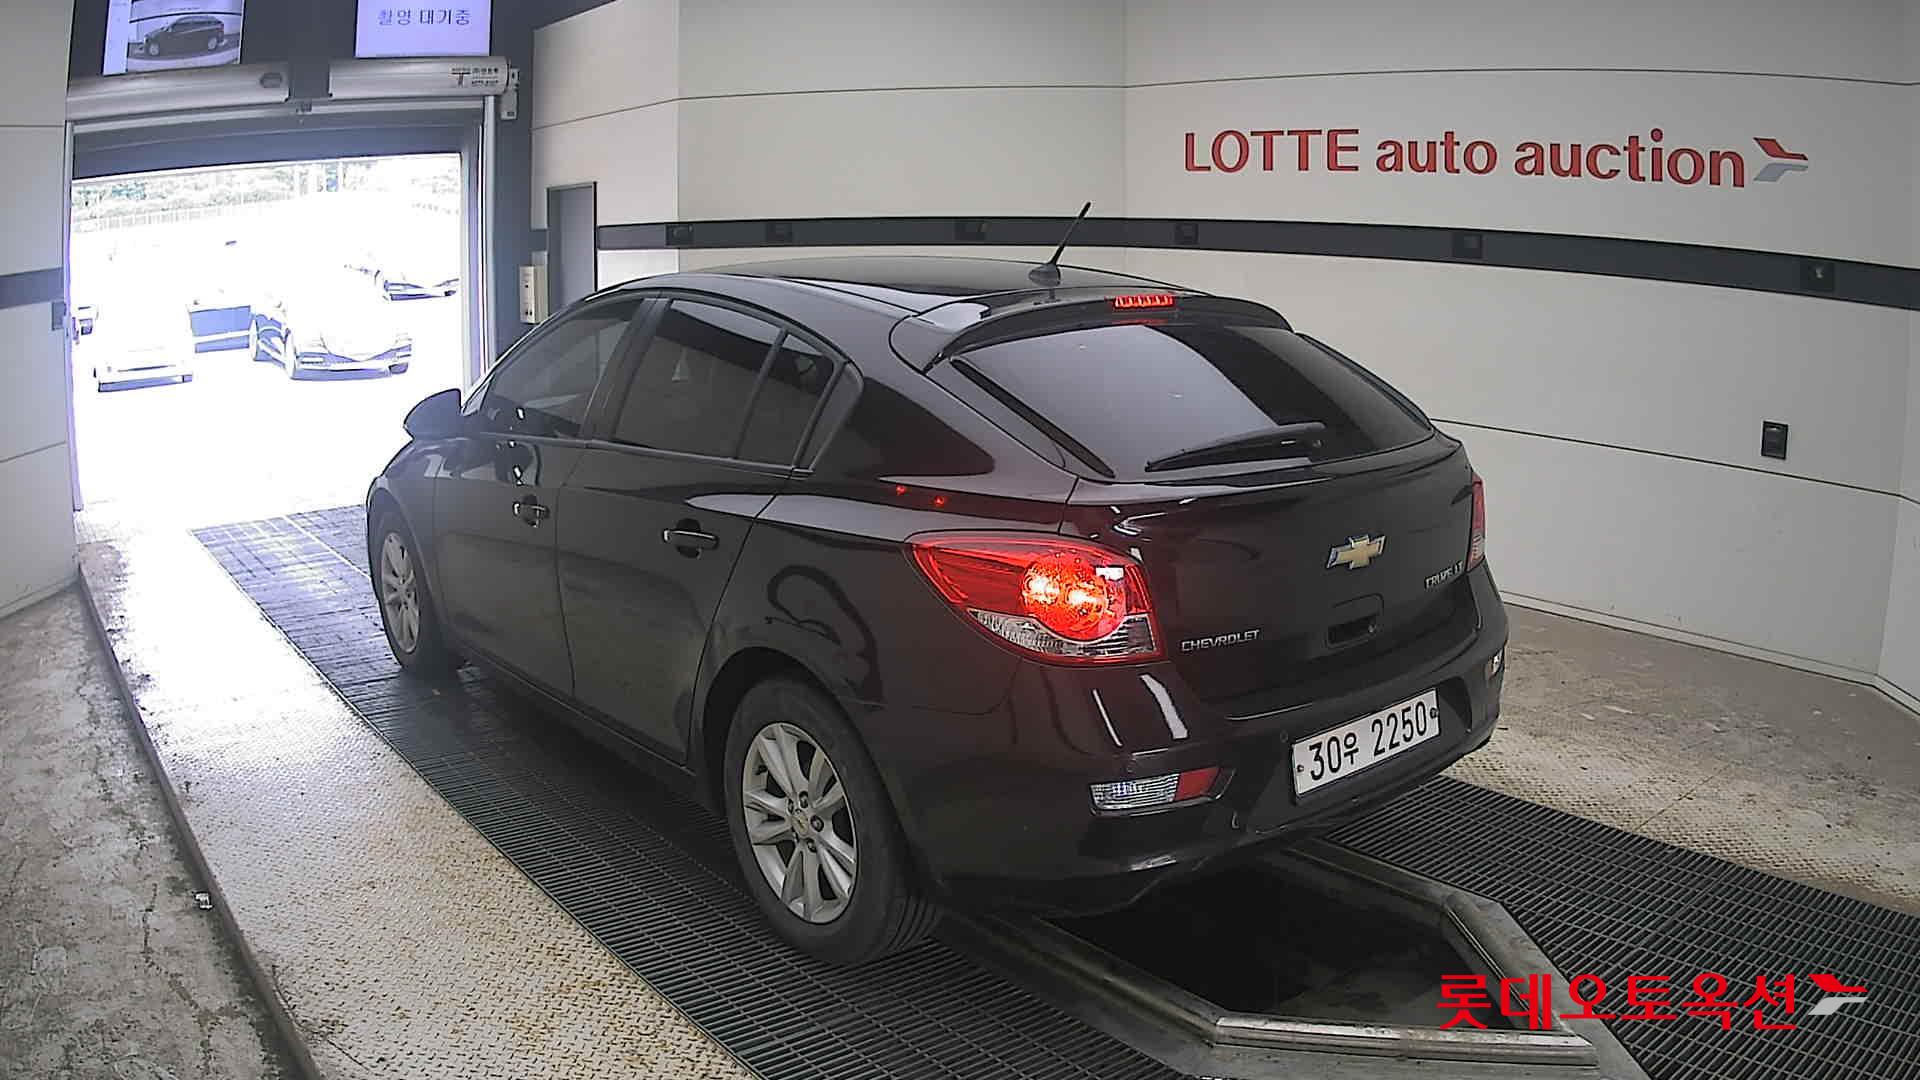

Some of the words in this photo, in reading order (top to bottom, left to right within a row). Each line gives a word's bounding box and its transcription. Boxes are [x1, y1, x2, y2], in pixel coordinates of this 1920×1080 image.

[419, 8, 471, 26] 대기중
[1184, 129, 1359, 171] LOTTE
[1376, 130, 1498, 175] auto
[1514, 129, 1746, 188] auction
[1180, 628, 1262, 653] CHEVROLET
[1308, 724, 1360, 781] 30우
[1372, 701, 1428, 757] 2250
